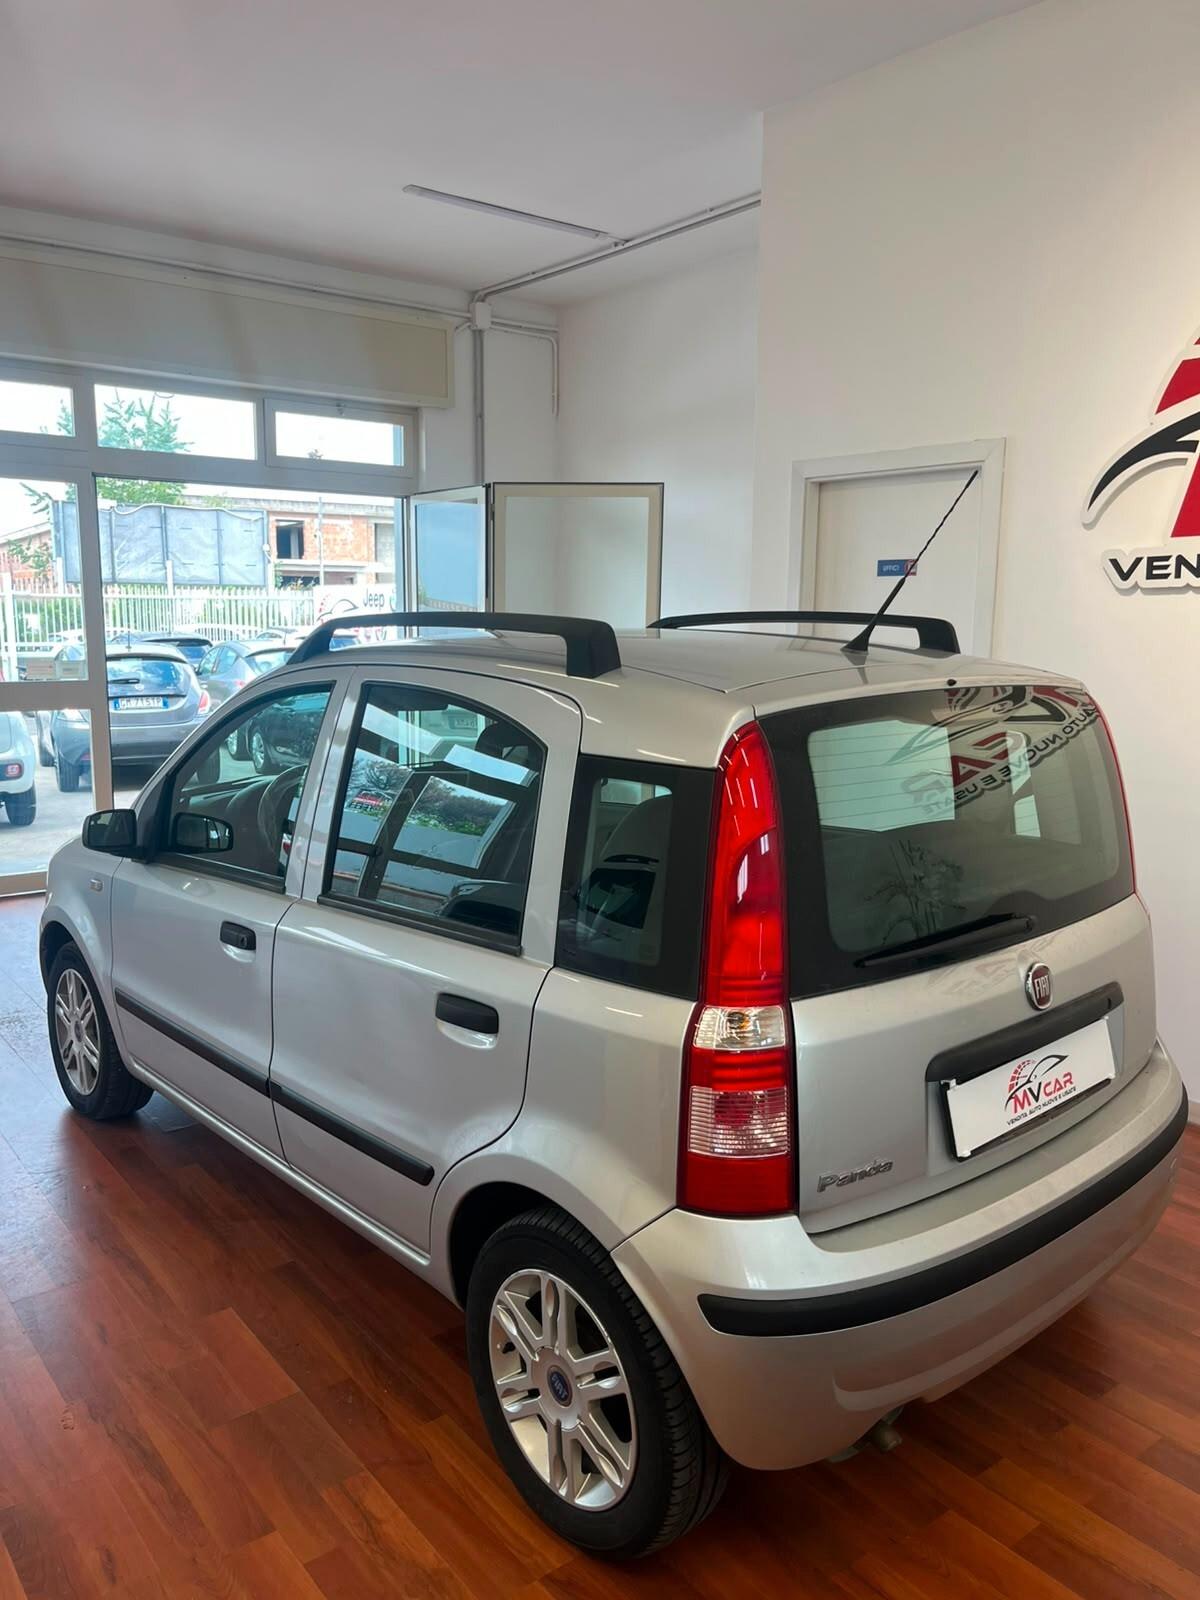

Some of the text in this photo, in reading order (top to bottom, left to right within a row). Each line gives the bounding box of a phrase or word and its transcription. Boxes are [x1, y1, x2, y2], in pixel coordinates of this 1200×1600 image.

[363, 588, 385, 609] Jeep
[1033, 974, 1049, 1000] FIAT
[1028, 1104, 1042, 1116] AUTO
[816, 1159, 893, 1193] Panda
